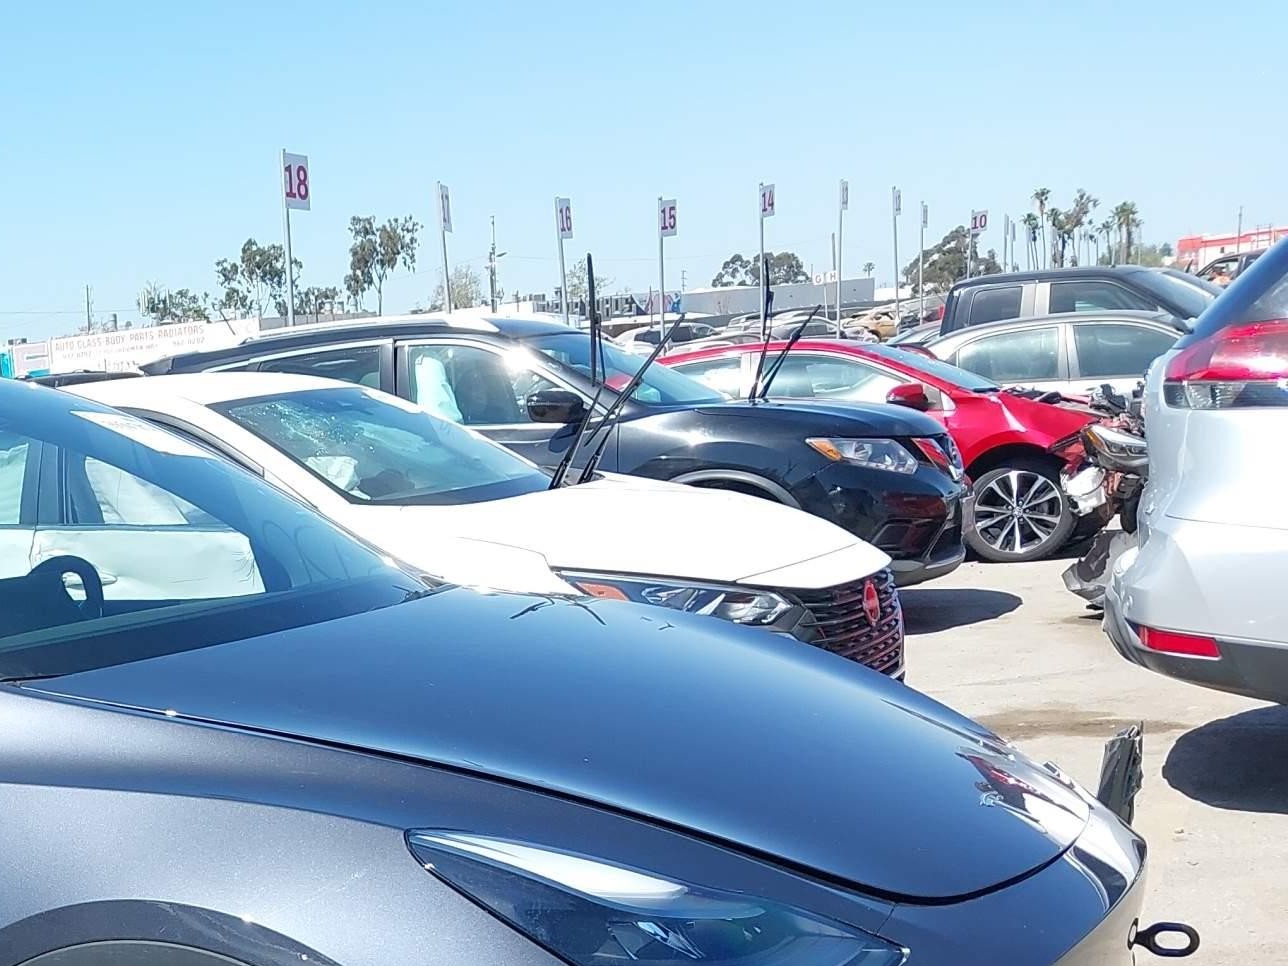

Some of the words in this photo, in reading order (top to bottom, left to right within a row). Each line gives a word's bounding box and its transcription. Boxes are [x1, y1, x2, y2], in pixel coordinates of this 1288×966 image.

[284, 164, 310, 200] 18
[762, 190, 774, 212] 14
[559, 206, 572, 232] 16
[660, 206, 677, 232] 15
[971, 213, 988, 231] 10
[814, 274, 822, 284] G
[829, 271, 836, 281] H
[55, 341, 75, 351] AUTO
[105, 335, 125, 346] BODY
[129, 330, 155, 342] PARTS
[158, 325, 205, 338] RADIATORS
